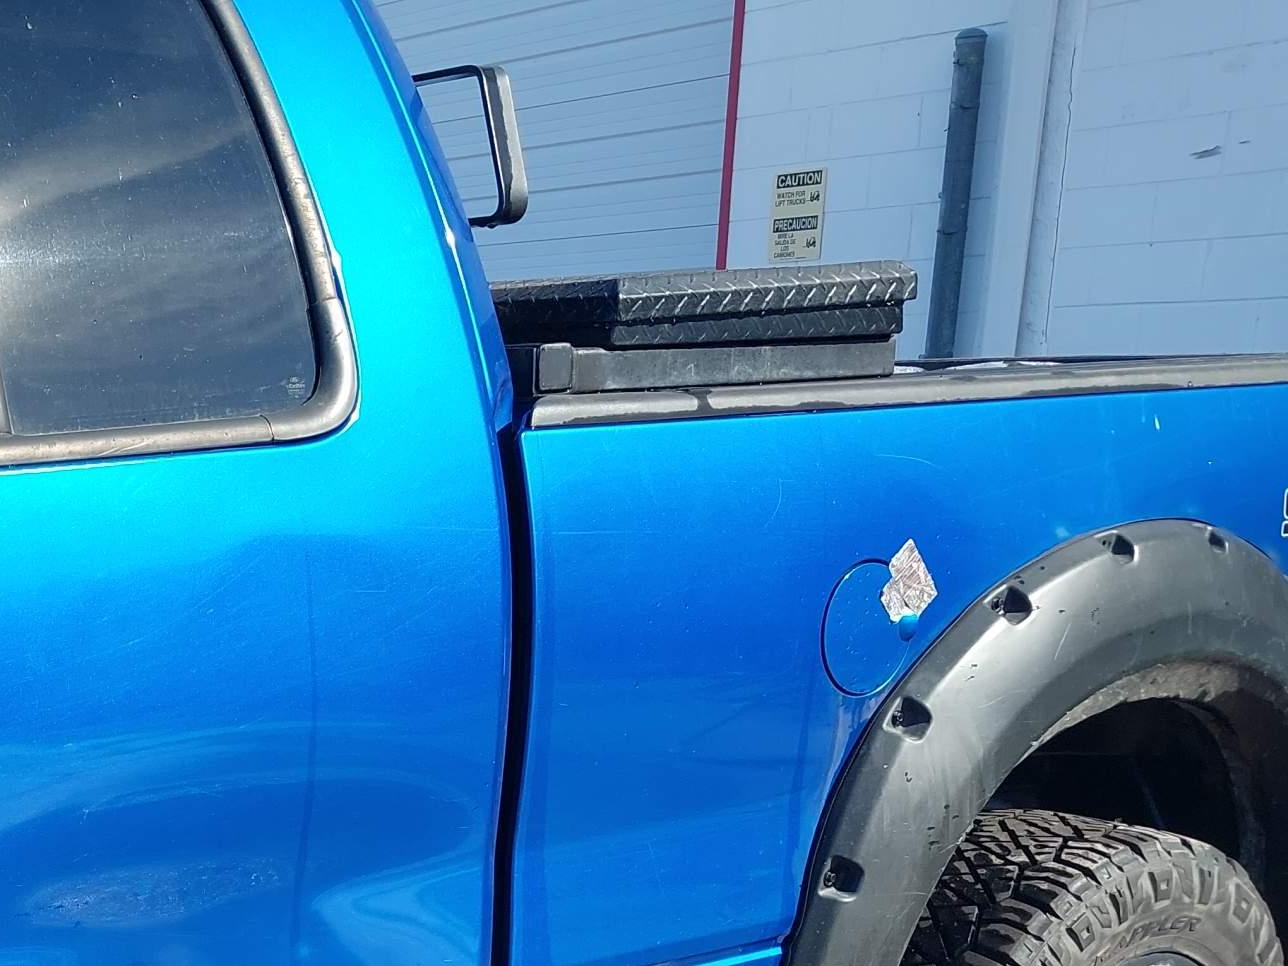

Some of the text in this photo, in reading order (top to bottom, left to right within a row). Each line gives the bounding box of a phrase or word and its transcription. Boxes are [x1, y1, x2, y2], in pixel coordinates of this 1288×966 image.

[778, 171, 821, 187] CAUTION
[777, 190, 805, 199] WATCH FOR
[786, 198, 806, 206] TRUCKS
[774, 217, 817, 231] PRECAUCION
